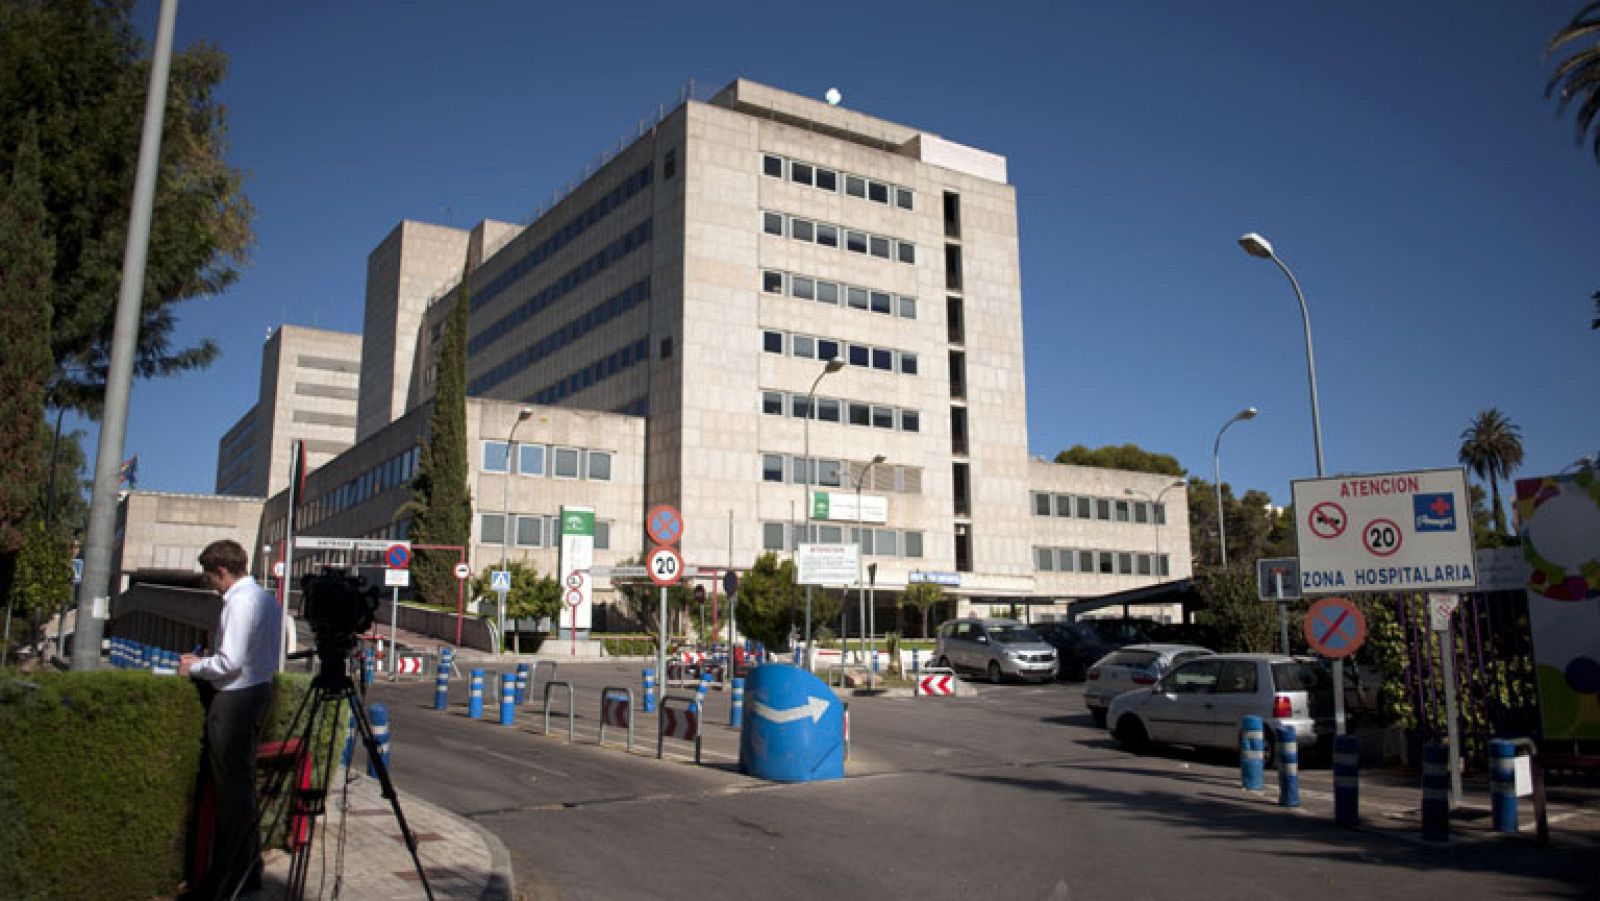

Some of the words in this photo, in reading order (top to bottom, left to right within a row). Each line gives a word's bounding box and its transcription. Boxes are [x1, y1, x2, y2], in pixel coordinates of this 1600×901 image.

[1340, 476, 1419, 497] ATENCION
[1371, 527, 1395, 547] 20
[656, 556, 676, 574] 20
[1302, 571, 1345, 588] ZONA
[1354, 564, 1472, 585] HOSPITALARIA
